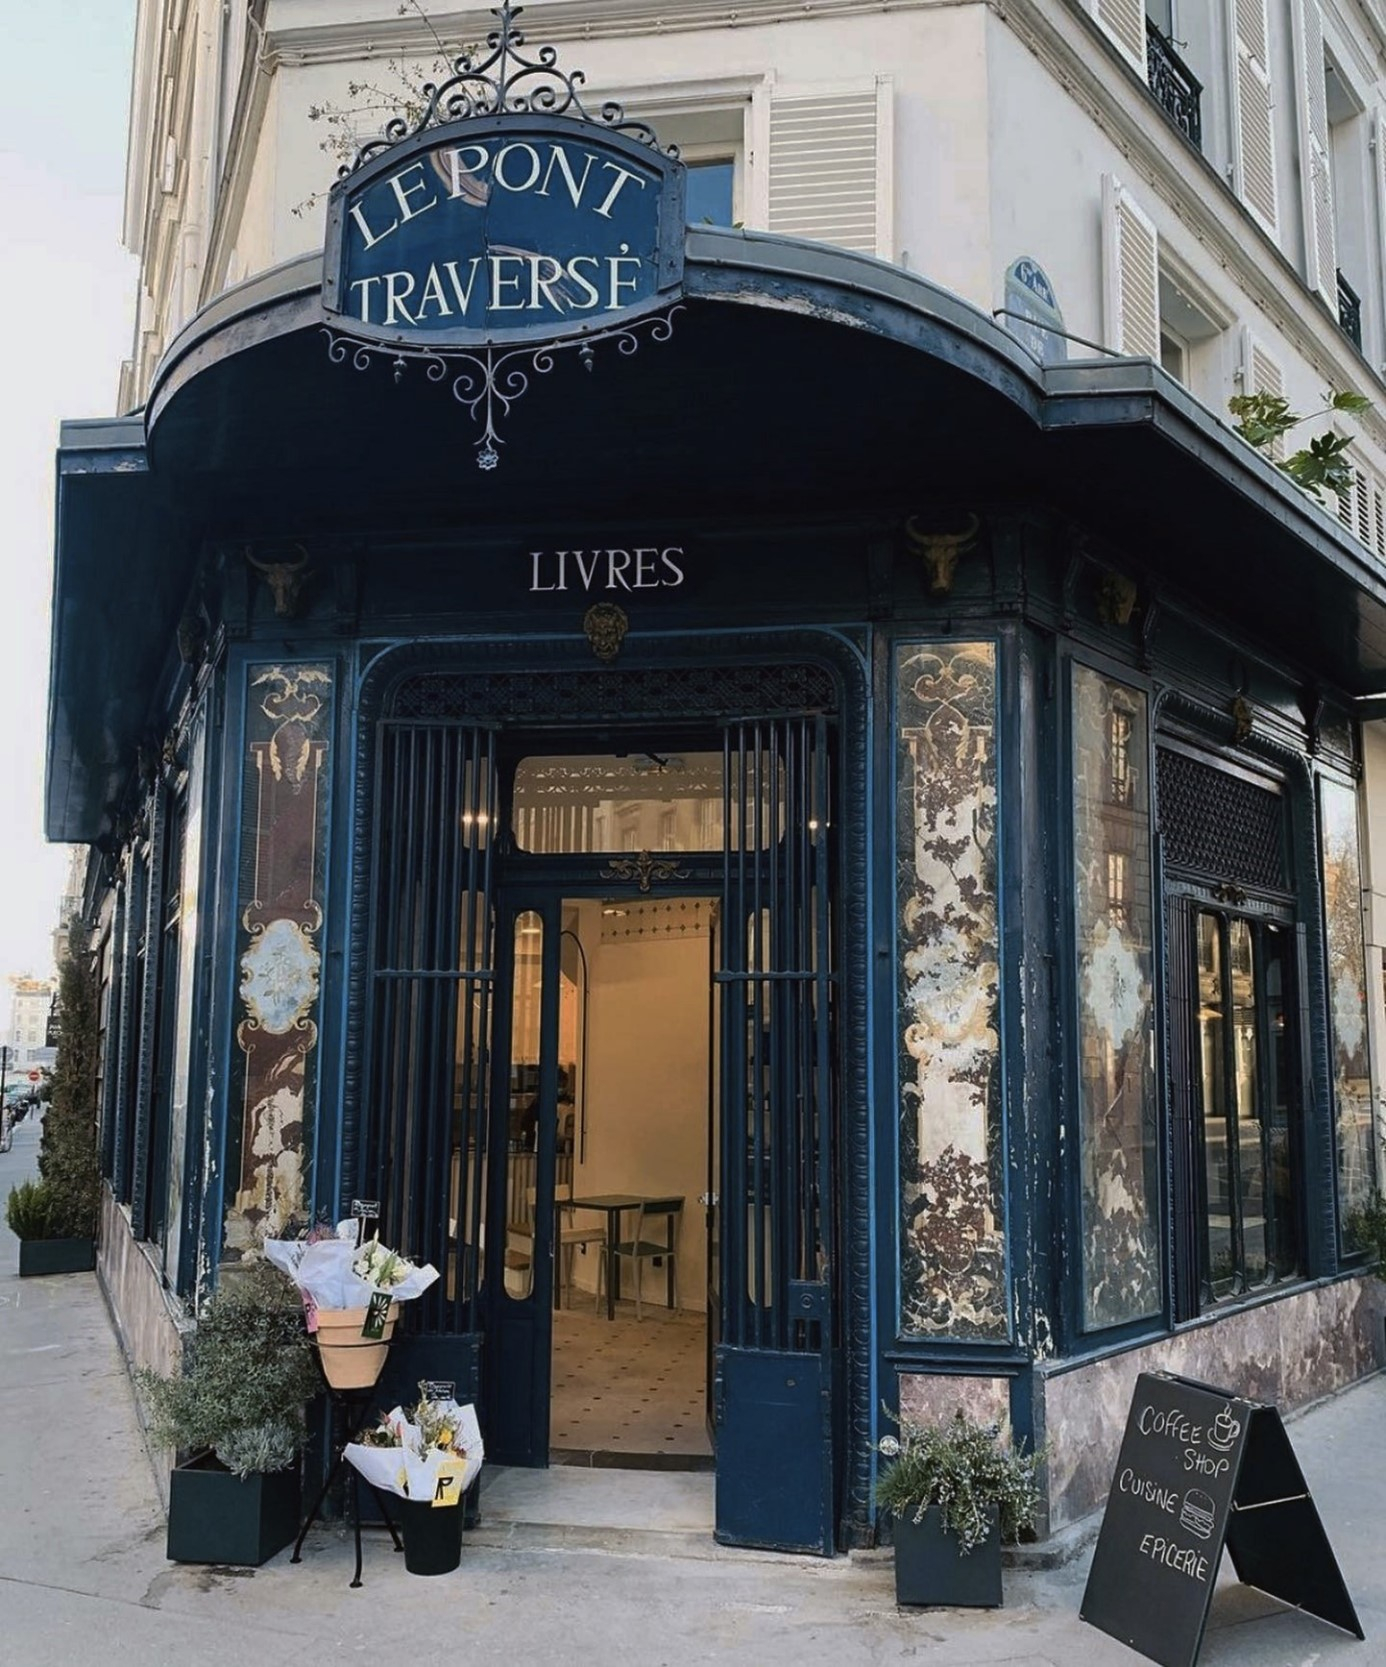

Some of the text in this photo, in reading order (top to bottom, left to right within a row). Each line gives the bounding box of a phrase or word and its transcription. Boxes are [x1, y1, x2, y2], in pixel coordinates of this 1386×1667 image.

[348, 143, 646, 252] LE PONT
[350, 243, 642, 327] TRAVERSÉ
[529, 547, 685, 593] LIVRES
[1139, 1405, 1203, 1445] COFFEE
[1183, 1448, 1230, 1480] SHOP
